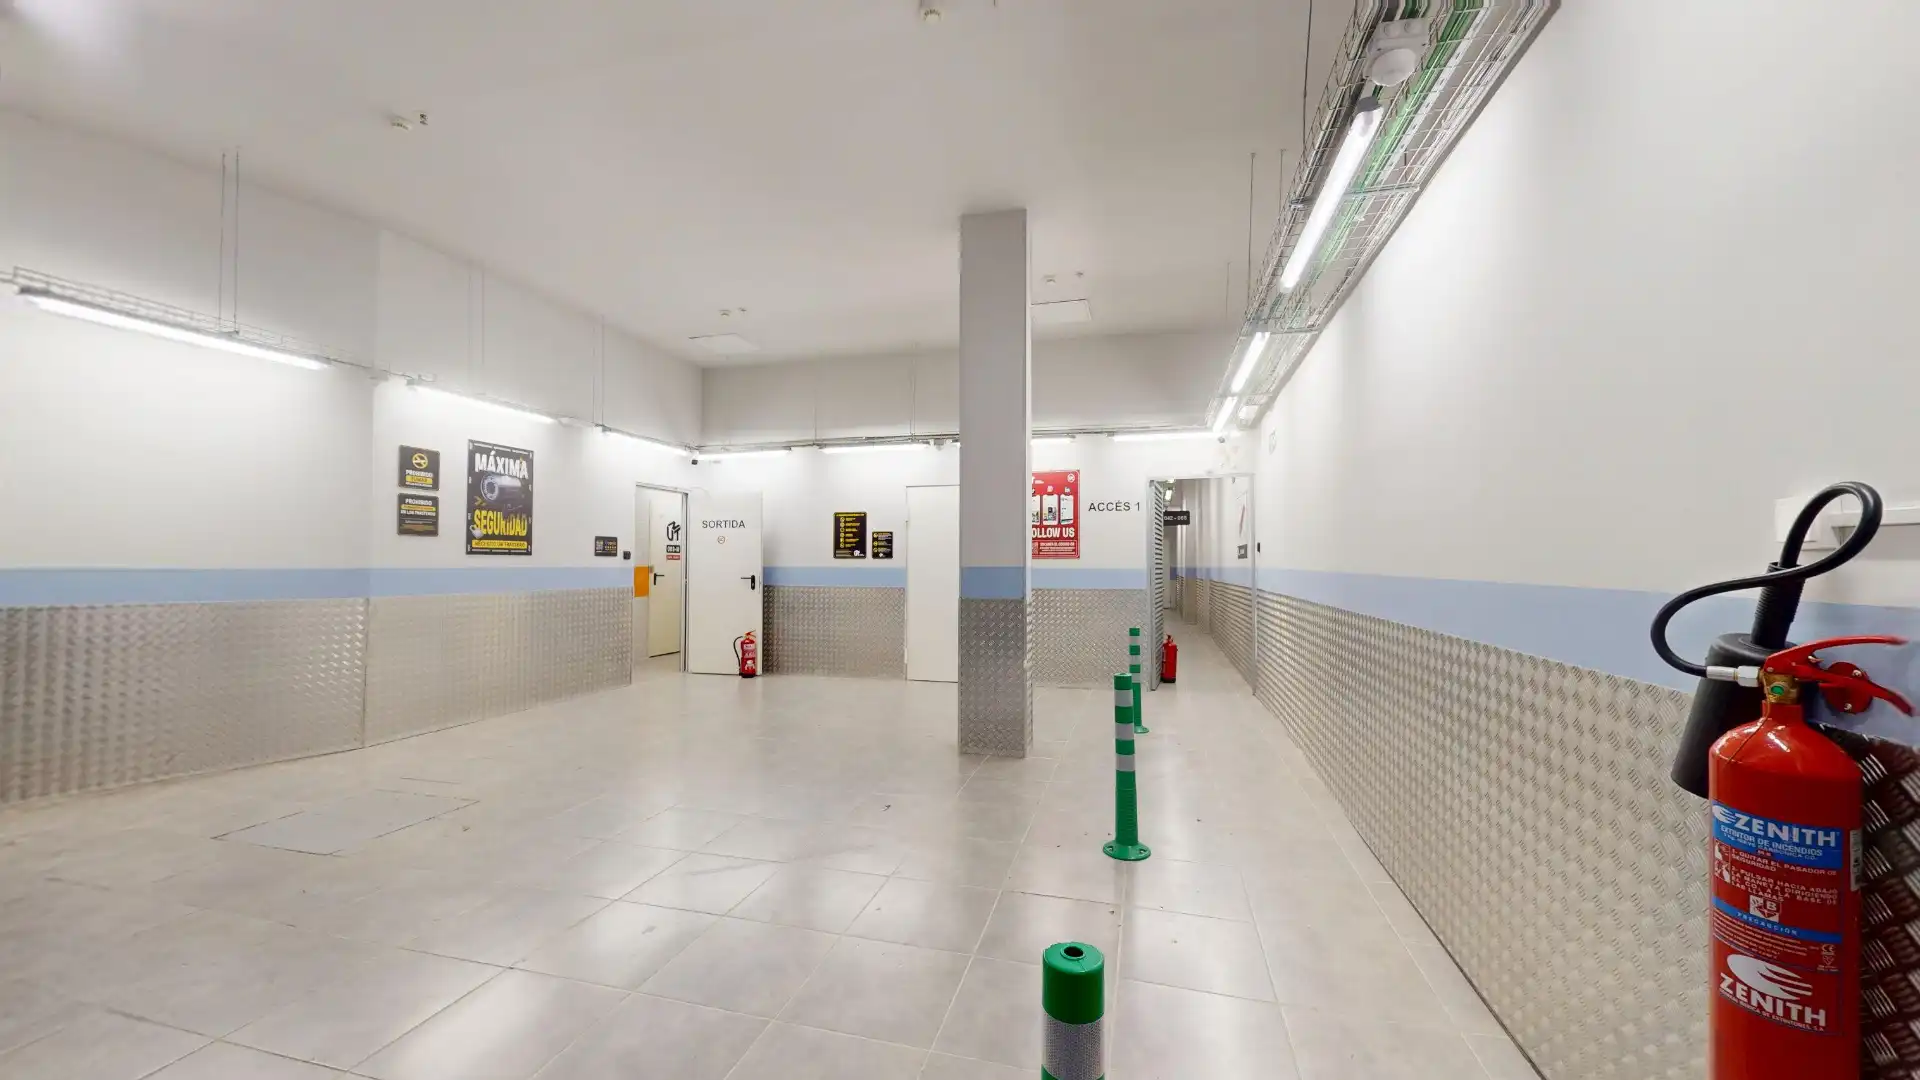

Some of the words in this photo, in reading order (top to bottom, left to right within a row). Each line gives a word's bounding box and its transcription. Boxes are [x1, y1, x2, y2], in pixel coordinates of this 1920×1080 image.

[475, 451, 529, 479] MÁXIMA
[1088, 500, 1131, 512] ACCÉS
[1135, 502, 1141, 511] 1
[474, 509, 528, 537] SEGURIDAD
[702, 520, 746, 529] SORTIDA
[1032, 527, 1061, 538] OLLOW
[1062, 527, 1075, 538] US
[1720, 824, 1756, 844] EXTINTOR
[1757, 838, 1770, 849] DE
[1772, 841, 1824, 857] INCENDIOS
[1734, 813, 1836, 848] ZENITH
[1731, 853, 1777, 872] SEGURIDAD
[1739, 851, 1768, 865] QUITAR
[1770, 860, 1782, 869] EL
[1783, 863, 1826, 875] PASADOR
[1739, 868, 1774, 884] PULSAR
[1777, 880, 1806, 892] HACIA
[1809, 887, 1838, 895] ABAJO
[1743, 875, 1781, 891] MANETA
[1784, 886, 1838, 900] DIRIGIENDO
[1747, 886, 1785, 902] LLAMAS
[1766, 900, 1777, 911] B
[1777, 891, 1791, 899] LA
[1796, 894, 1822, 904] BASE
[1719, 972, 1826, 1027] ZENITH
